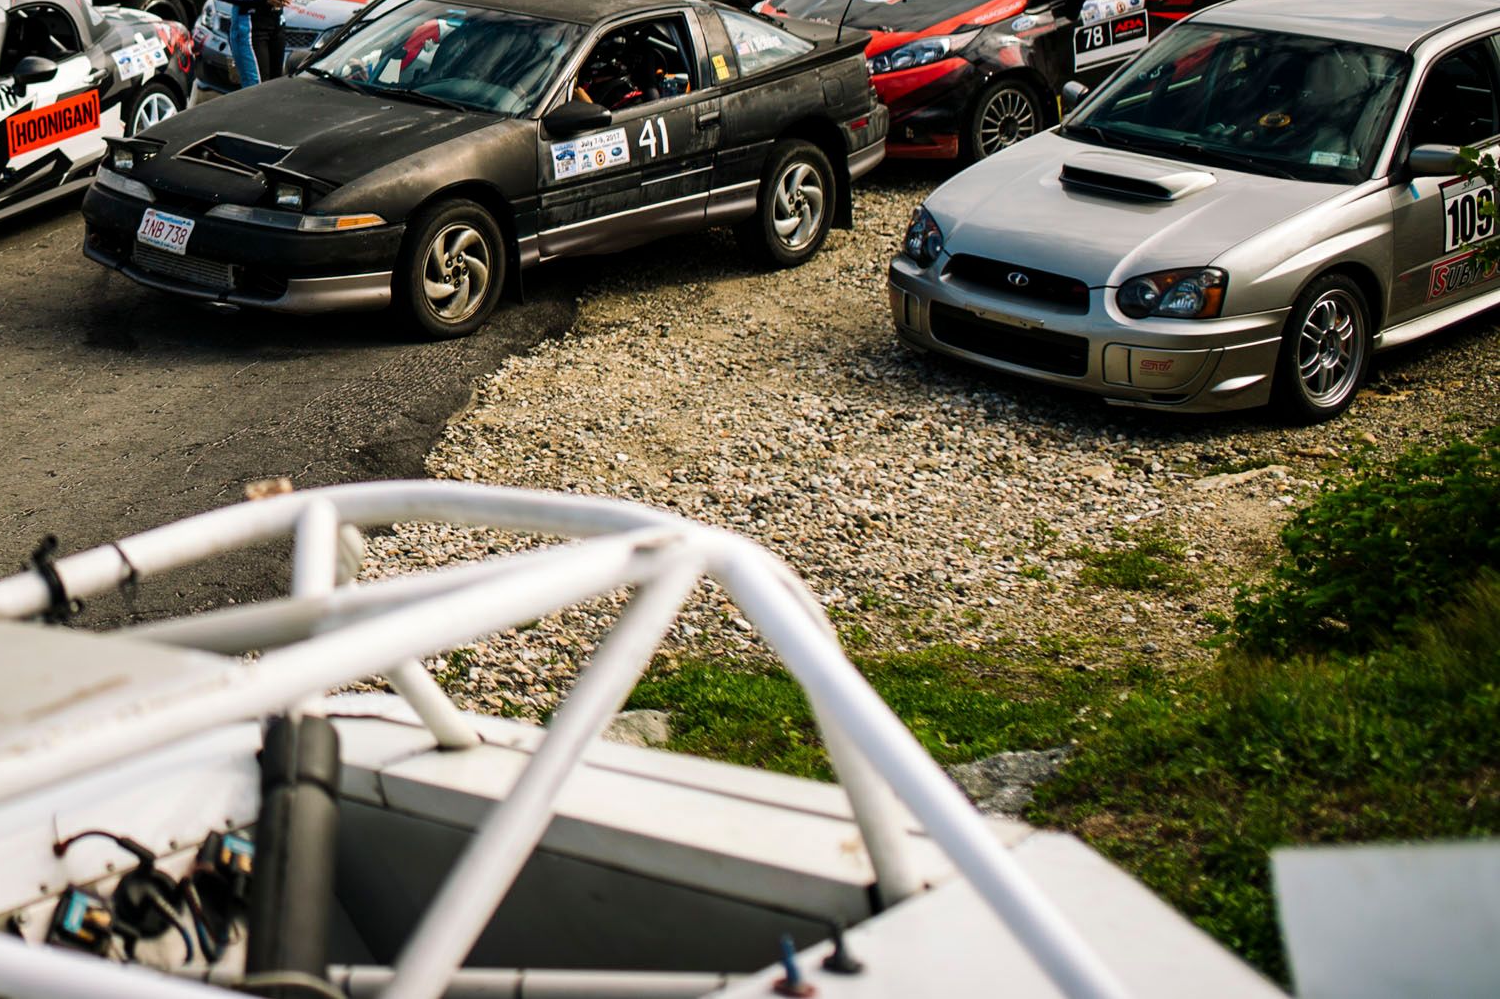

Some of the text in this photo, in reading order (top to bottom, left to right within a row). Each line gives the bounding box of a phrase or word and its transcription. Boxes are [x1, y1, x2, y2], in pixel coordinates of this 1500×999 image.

[1083, 25, 1104, 49] 78
[1114, 18, 1145, 34] ARA
[580, 139, 594, 149] July
[606, 132, 620, 142] 2017
[639, 117, 669, 158] 41
[1447, 188, 1493, 247] 109
[141, 218, 165, 239] 1NB
[164, 224, 188, 245] 738
